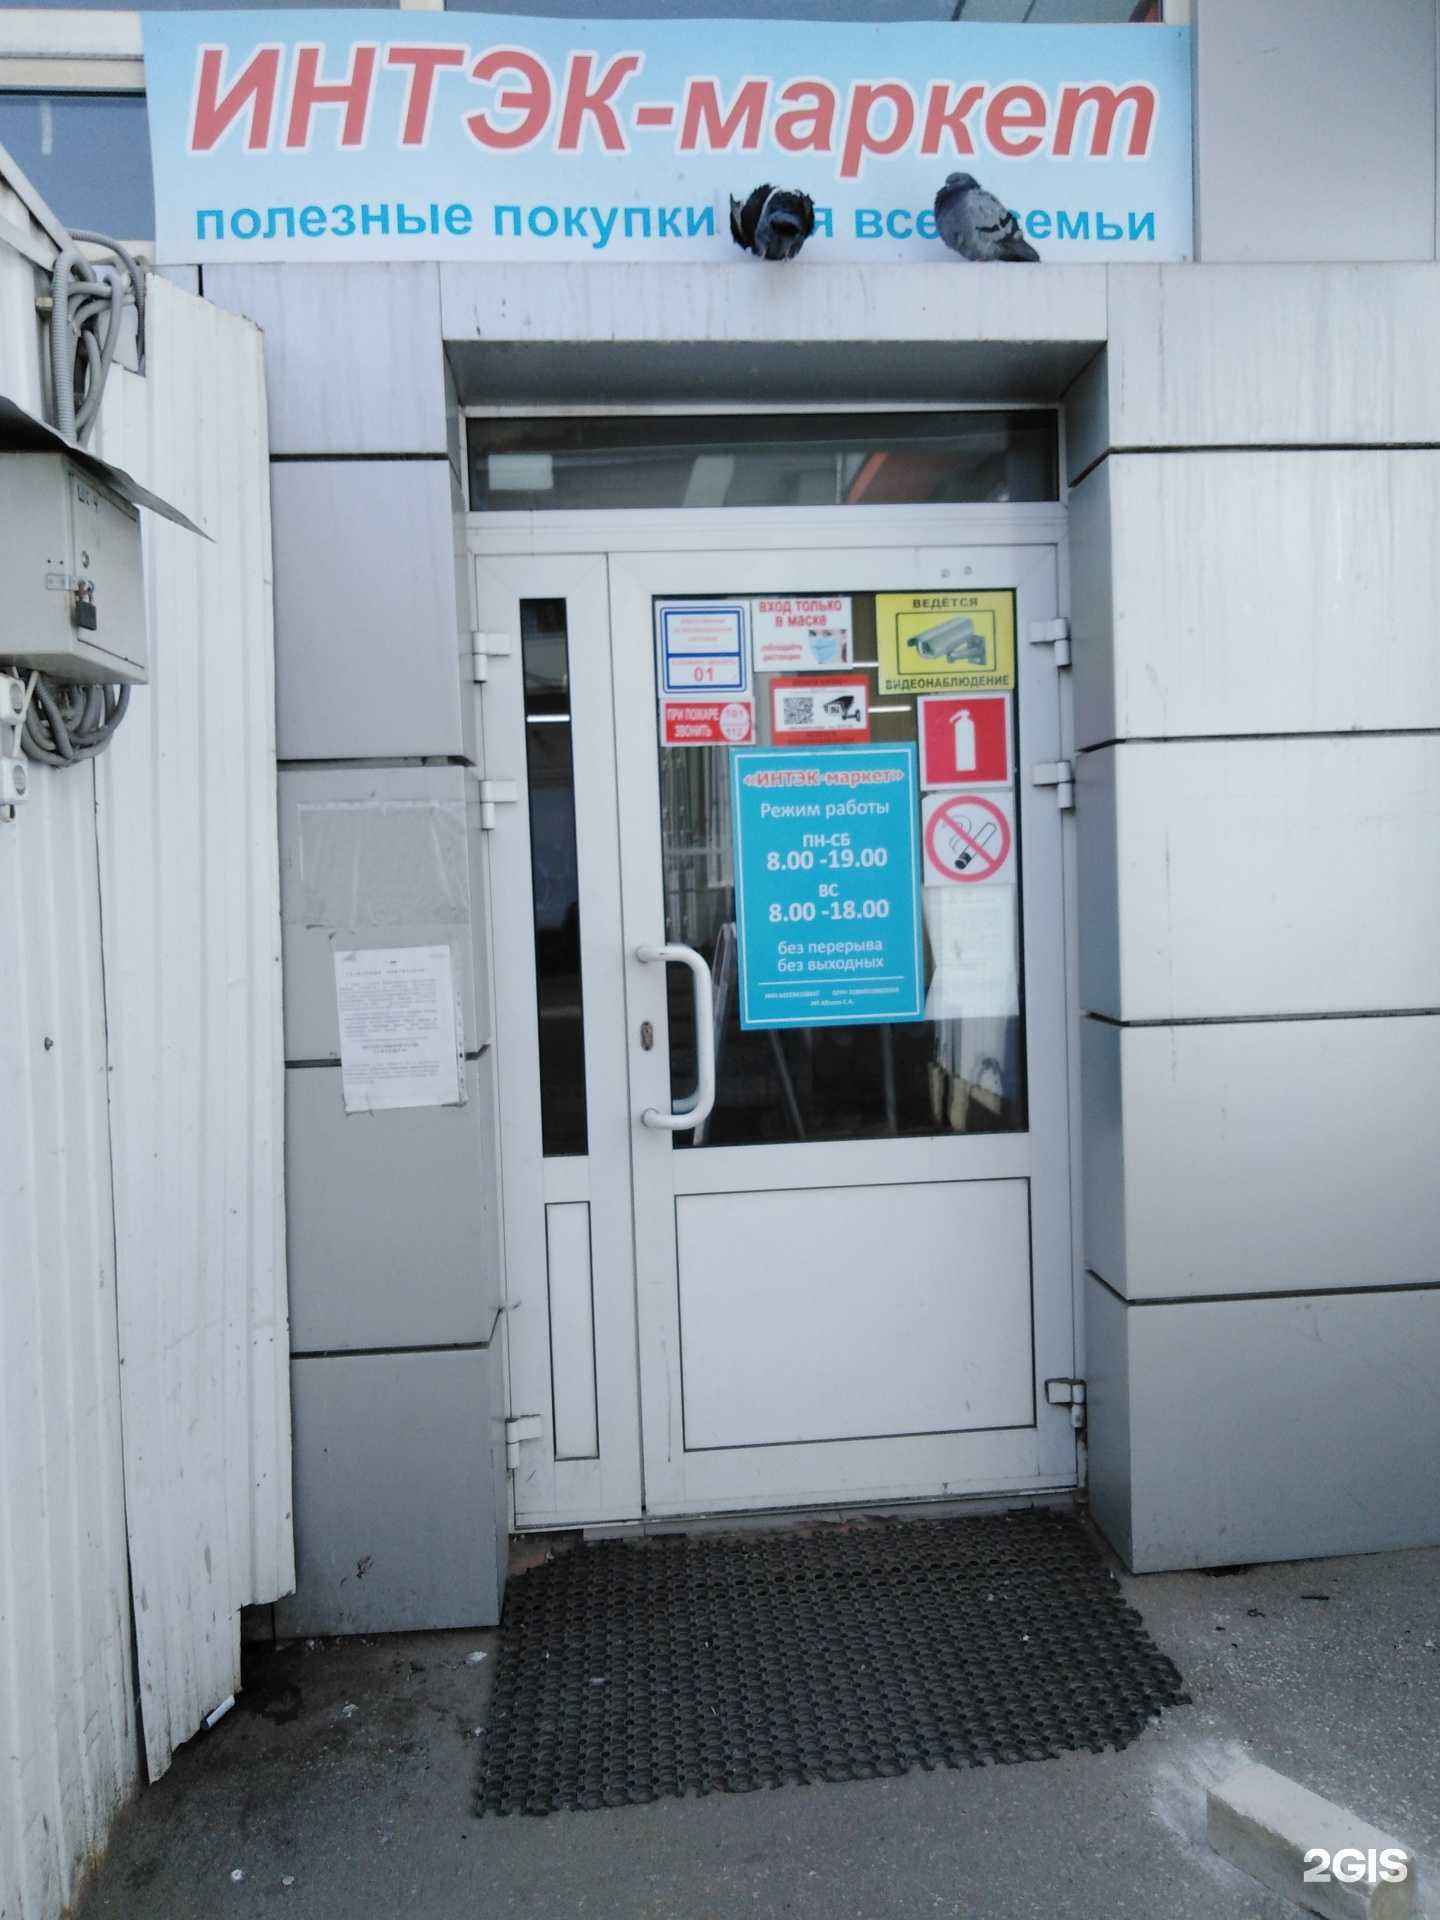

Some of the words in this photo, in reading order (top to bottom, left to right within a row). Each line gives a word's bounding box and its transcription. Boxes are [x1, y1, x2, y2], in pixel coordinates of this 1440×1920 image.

[190, 46, 1157, 178] ИНТЭК-маркет
[196, 204, 473, 240] полезные
[494, 204, 716, 248] покупки
[854, 208, 939, 239] все
[759, 601, 792, 613] ВХОД
[796, 599, 842, 611] ТОЛЬКО
[694, 667, 715, 681] 01
[885, 675, 1009, 690] ВИДЕОНАБЛЮДЕНИЕ
[760, 803, 820, 818] Режим
[826, 801, 890, 819] работы
[803, 834, 851, 847] ПН-СБ
[767, 851, 814, 871] 8.00
[819, 884, 839, 897] ВС
[769, 902, 816, 922] 8.00
[778, 941, 804, 955] без
[808, 939, 883, 956] перерыва
[778, 958, 804, 972] без
[808, 956, 884, 972] выходных
